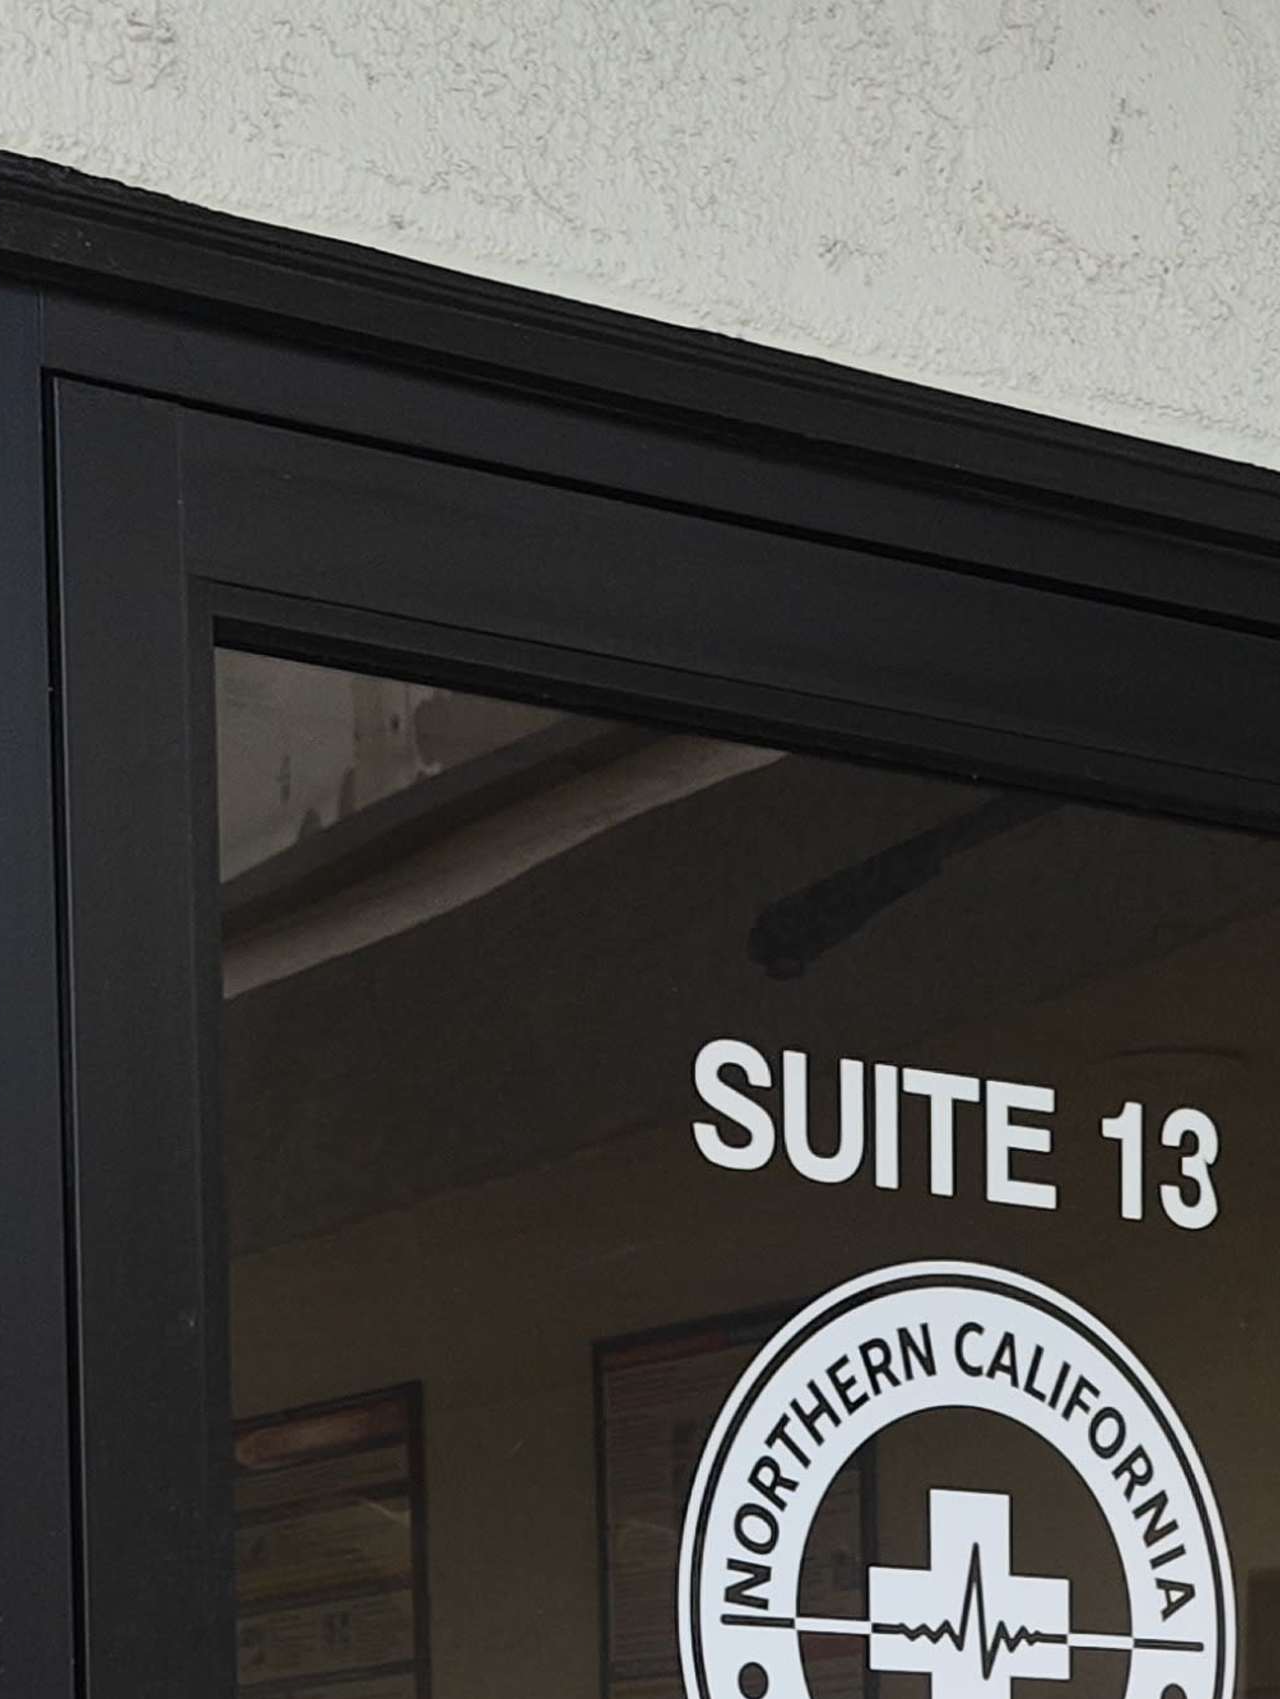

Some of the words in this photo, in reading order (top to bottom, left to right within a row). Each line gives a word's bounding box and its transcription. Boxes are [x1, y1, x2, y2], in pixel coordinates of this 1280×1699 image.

[693, 1038, 1058, 1209] SUITE
[1102, 1100, 1219, 1230] 13
[723, 1322, 937, 1611] NORTHERN
[954, 1321, 1196, 1621] CALIFORNIA
